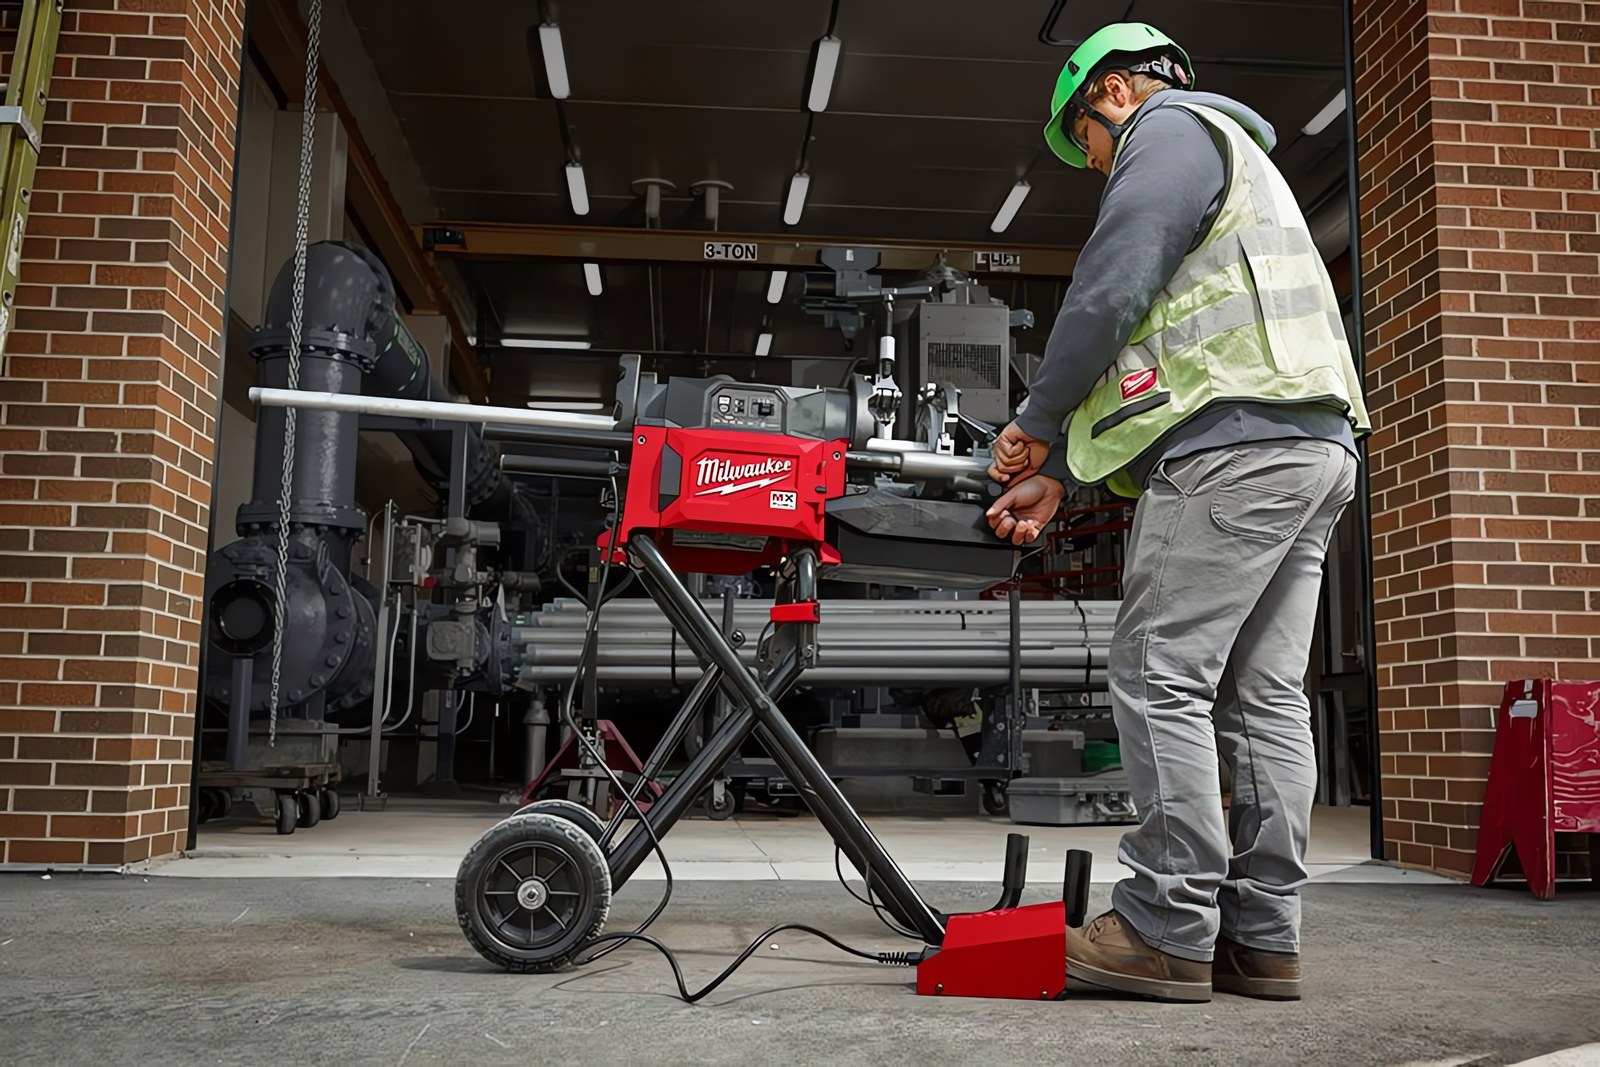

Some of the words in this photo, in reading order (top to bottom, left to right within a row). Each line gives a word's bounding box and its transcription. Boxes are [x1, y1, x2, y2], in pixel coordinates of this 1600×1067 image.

[705, 243, 756, 259] 3-TON
[696, 457, 792, 486] Milwaukee
[772, 493, 794, 503] MX
